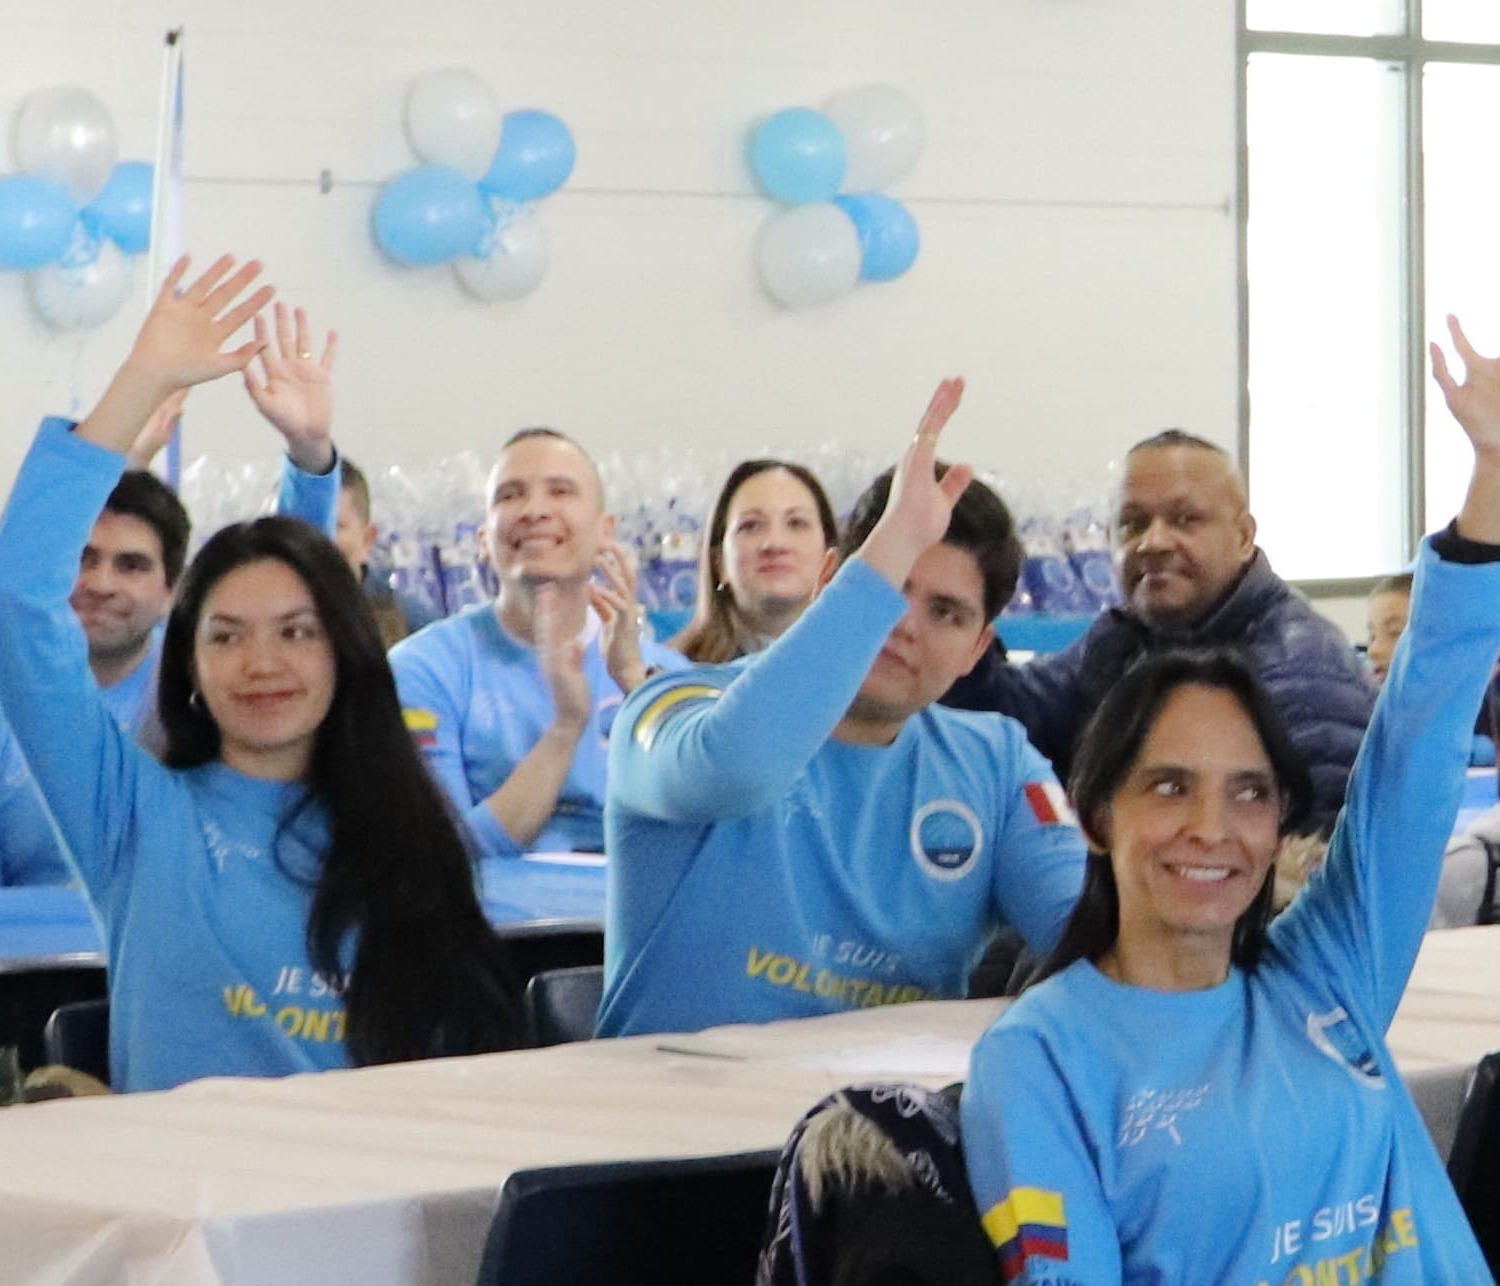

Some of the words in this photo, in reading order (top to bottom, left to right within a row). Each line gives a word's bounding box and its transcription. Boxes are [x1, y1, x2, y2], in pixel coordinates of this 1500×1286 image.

[273, 966, 300, 996] JE
[1271, 1219, 1301, 1264] JE
[1312, 1194, 1379, 1241] SUIS
